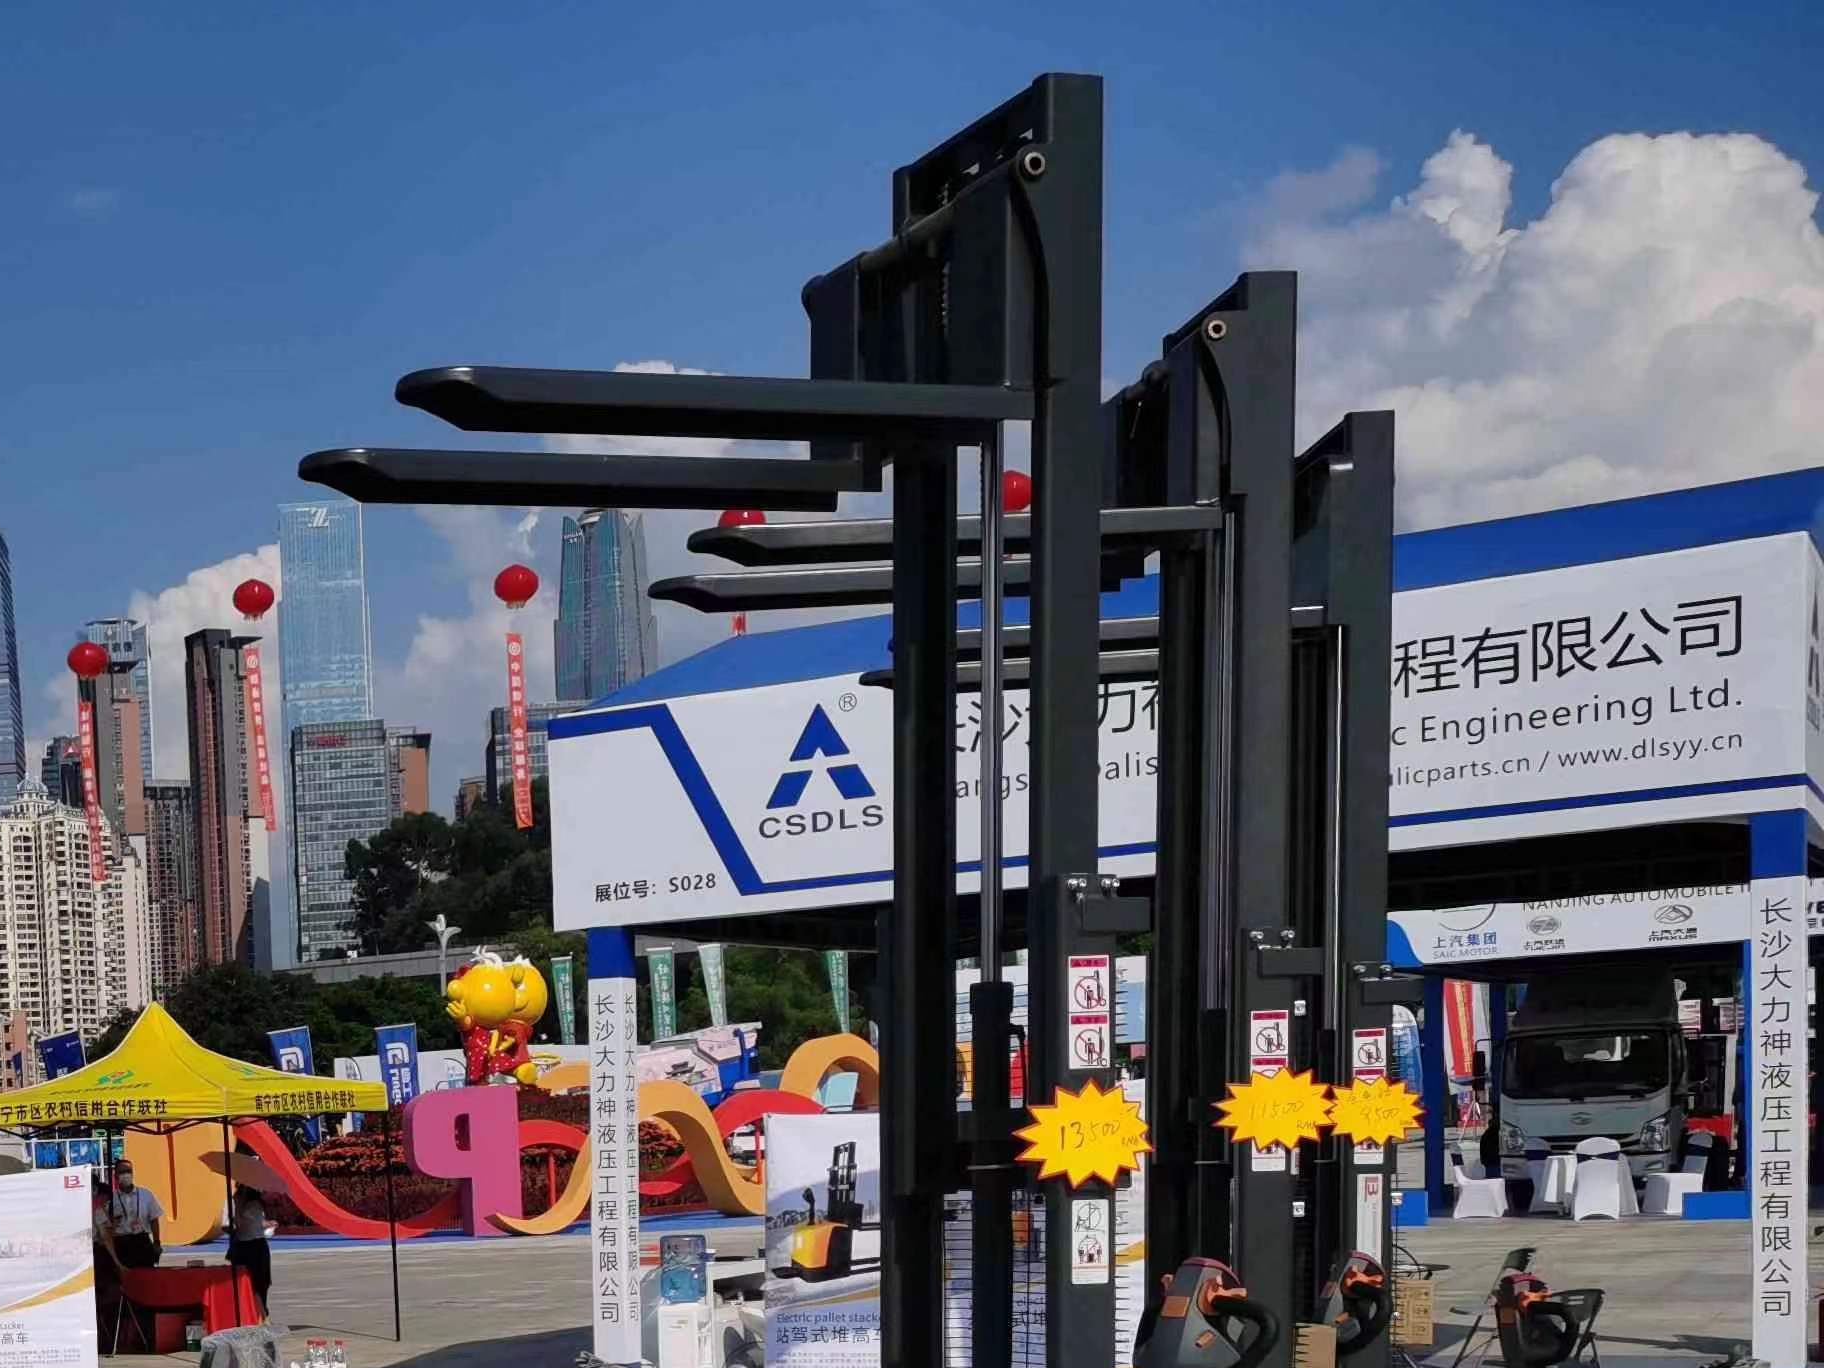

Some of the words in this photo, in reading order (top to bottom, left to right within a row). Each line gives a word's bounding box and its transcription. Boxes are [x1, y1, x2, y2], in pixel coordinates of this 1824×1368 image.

[1421, 694, 1653, 745] Engineering
[1669, 678, 1743, 714] Ltd.
[1557, 733, 1743, 768] www.dlsyy.cn
[758, 803, 885, 840] CSDLS
[1432, 931, 1497, 949] 上汽集团
[1432, 950, 1457, 960] SAIC
[1459, 947, 1499, 958] MOTOR
[1760, 897, 1792, 1318] 长沙大力神液压工程有限公司
[593, 993, 620, 1324] 长沙大力神液压工程有限公司
[776, 1312, 813, 1323] Electric
[815, 1311, 845, 1325] pallet
[849, 1310, 880, 1322] stack
